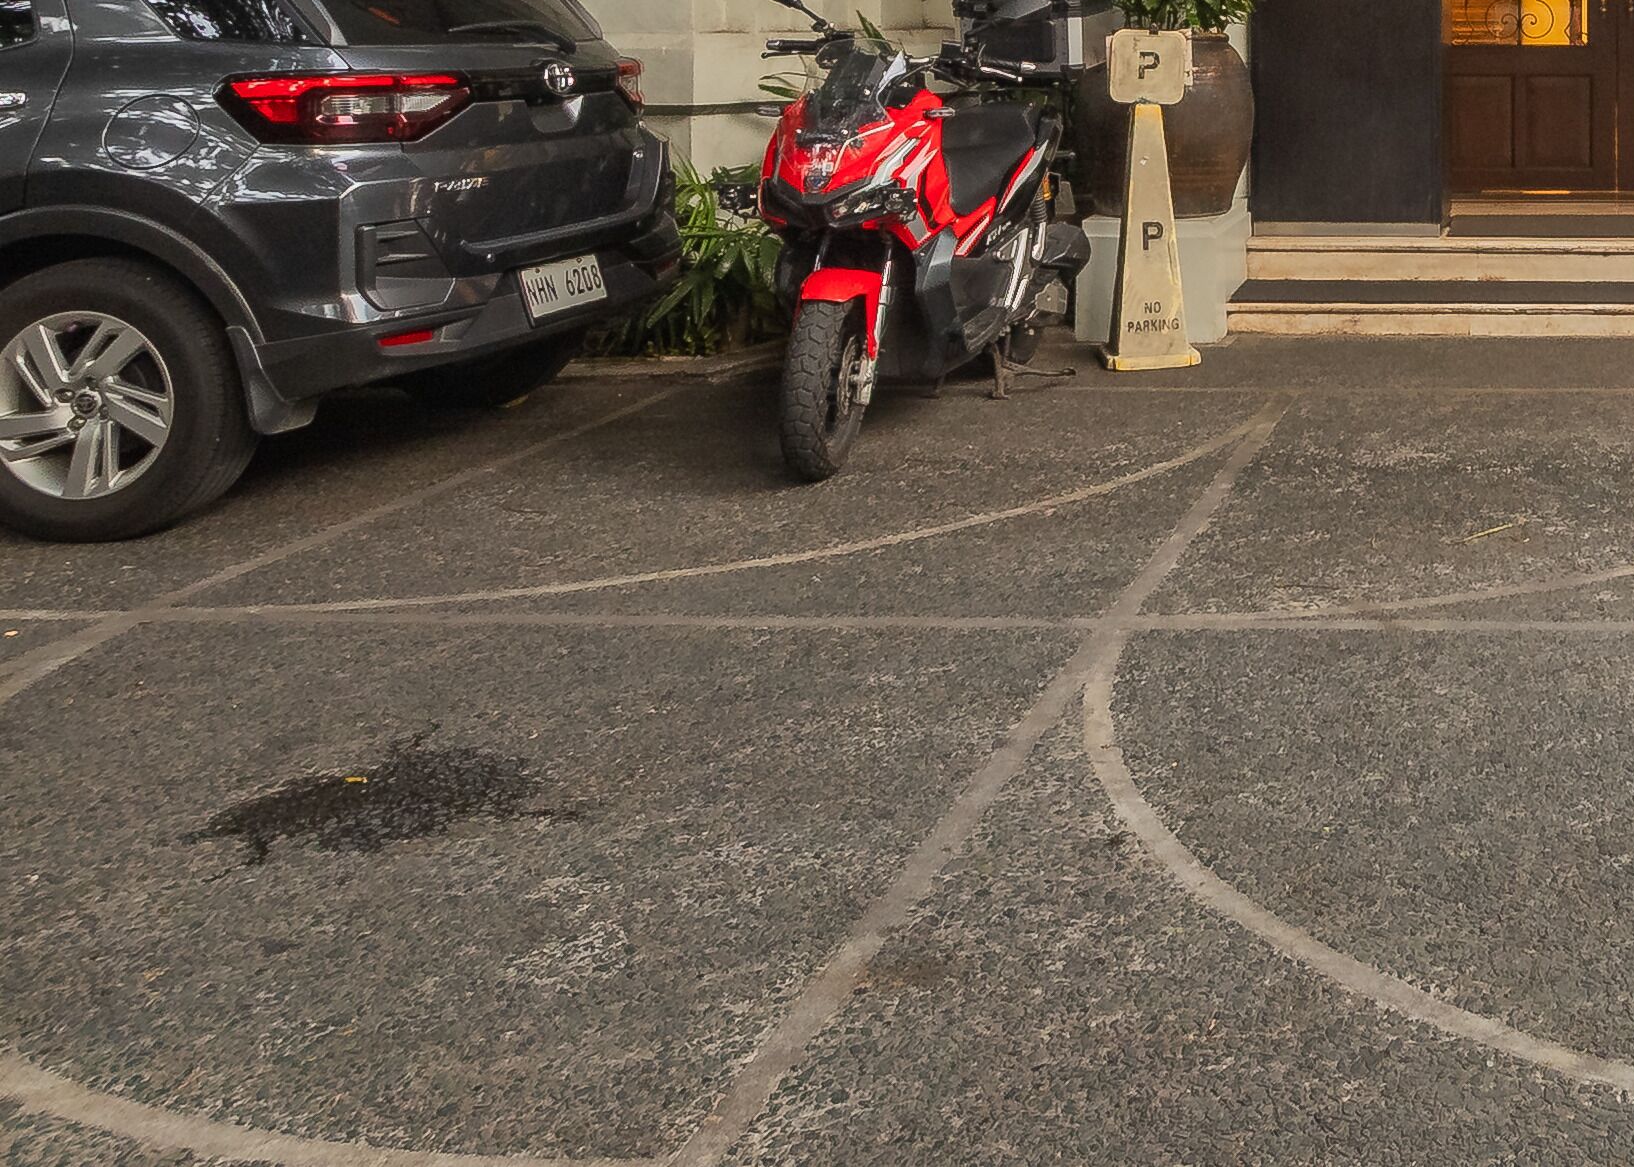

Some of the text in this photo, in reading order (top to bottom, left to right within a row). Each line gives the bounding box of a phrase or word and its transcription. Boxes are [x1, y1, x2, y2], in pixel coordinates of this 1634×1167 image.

[1138, 51, 1160, 80] P
[1142, 221, 1164, 251] P
[526, 264, 602, 307] NHN 6208
[1144, 301, 1162, 314] NO
[1127, 318, 1180, 333] PARKING
